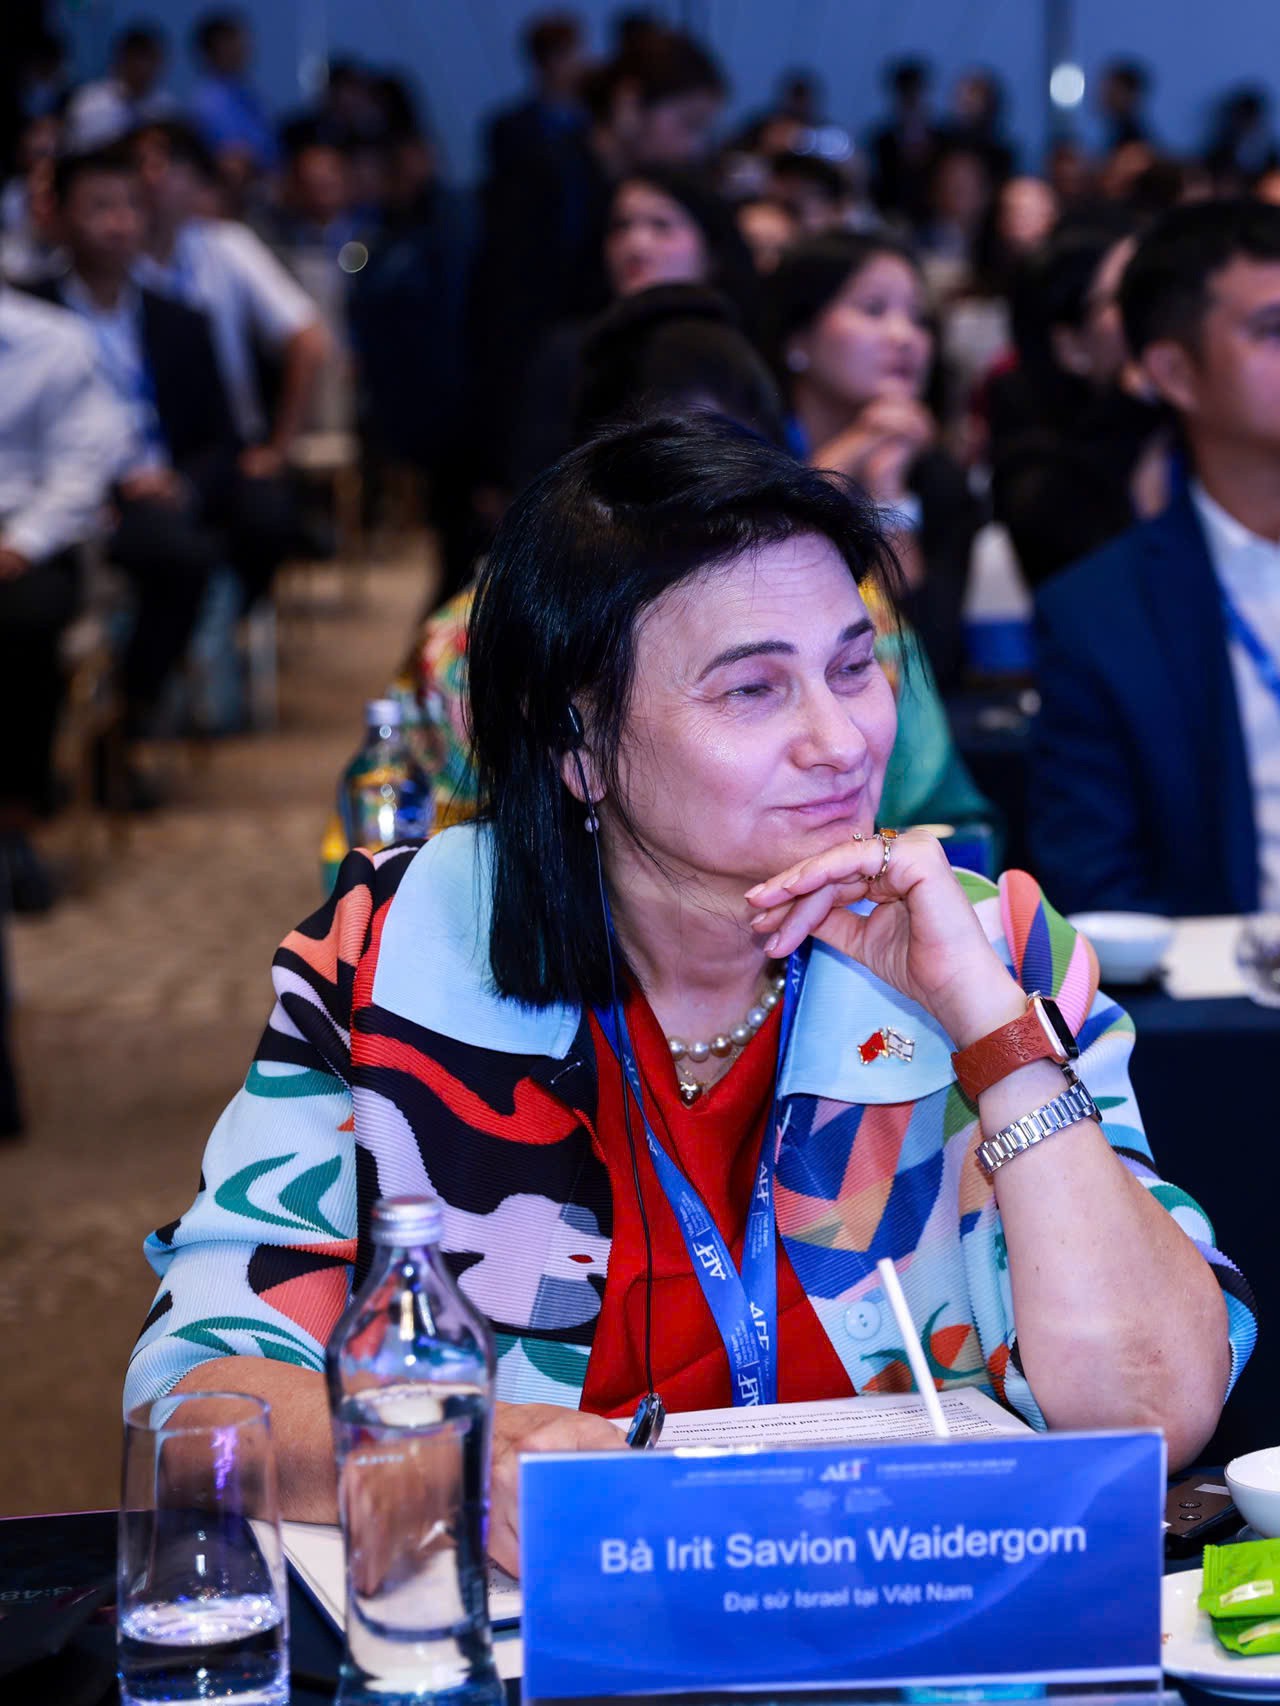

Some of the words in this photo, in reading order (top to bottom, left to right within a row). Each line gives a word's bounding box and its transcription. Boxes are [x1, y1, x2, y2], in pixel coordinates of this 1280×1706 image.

[692, 1242, 727, 1280] AEF
[672, 1424, 756, 1434] Transformation
[601, 1537, 654, 1574] Bà
[666, 1535, 715, 1571] Irit
[725, 1529, 857, 1569] Savion
[866, 1523, 1088, 1564] Waidergorn
[794, 1585, 850, 1609] Israel
[925, 1581, 974, 1602] Nam
